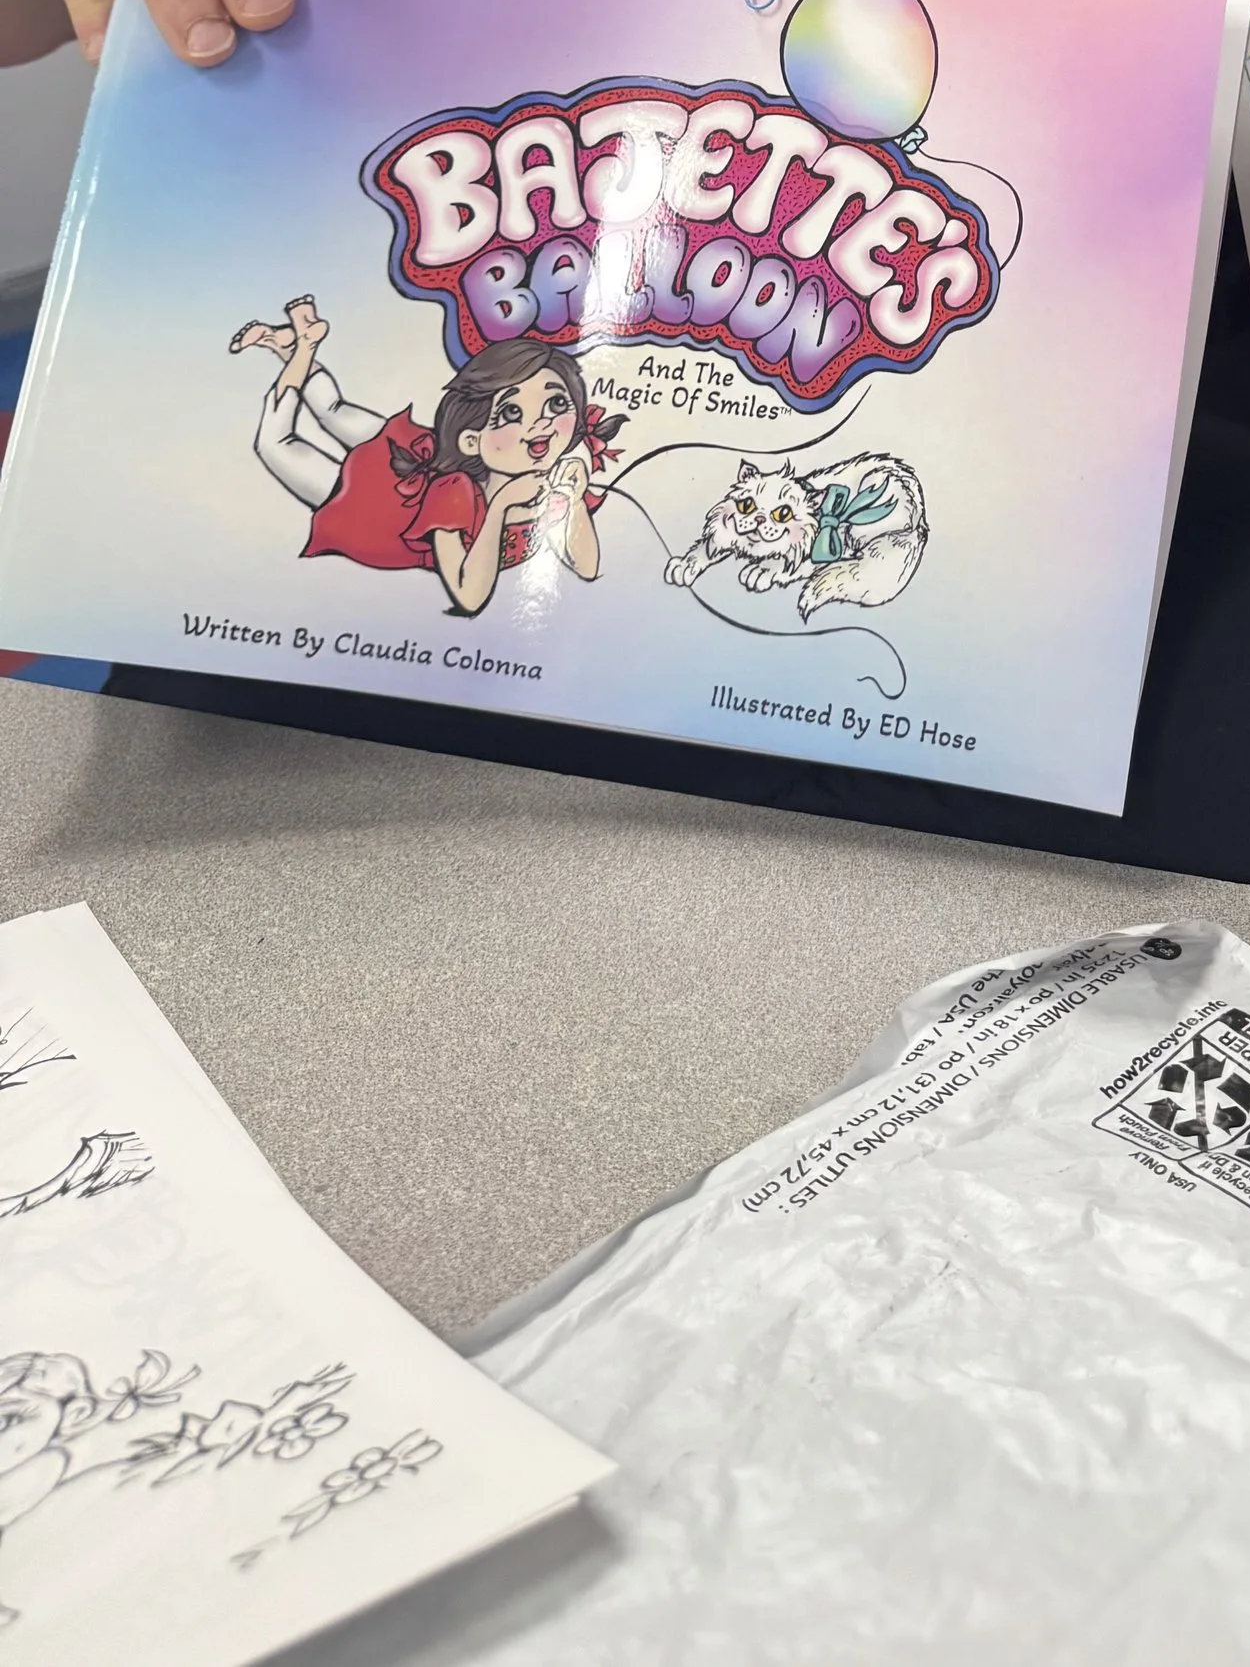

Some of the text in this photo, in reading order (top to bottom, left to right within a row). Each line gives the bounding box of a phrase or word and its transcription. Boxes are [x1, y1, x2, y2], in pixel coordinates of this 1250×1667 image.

[390, 97, 982, 346] BAJETTE'S
[464, 220, 860, 385] BALLOON
[638, 355, 735, 387] And The
[591, 377, 663, 411] Magic
[671, 386, 703, 415] Of
[183, 613, 543, 681] Written By Claudia Colonna
[710, 685, 977, 752] Illustrated By ED Hose
[1054, 982, 1064, 993] /
[1062, 971, 1087, 984] in
[1085, 951, 1149, 995] USABLE
[937, 993, 978, 1025] USA
[1015, 1004, 1031, 1014] x
[1028, 987, 1055, 1006] po
[932, 1026, 943, 1038] /
[972, 1028, 998, 1043] in
[978, 990, 1088, 1069] DIMENSIONS
[993, 1013, 1019, 1030] 18
[938, 1050, 966, 1072] po
[965, 1041, 977, 1054] /
[1099, 999, 1228, 1100] how2recycle.info
[970, 1065, 981, 1077] /
[847, 1108, 879, 1128] cm
[853, 1072, 972, 1156] DIMENSIONS
[831, 1125, 850, 1138] x
[780, 1138, 834, 1185] 45,72
[1129, 1150, 1198, 1193] USA ONLY
[1229, 1162, 1245, 1175] &
[741, 1180, 781, 1213] cm)
[788, 1152, 856, 1209] UTILES
